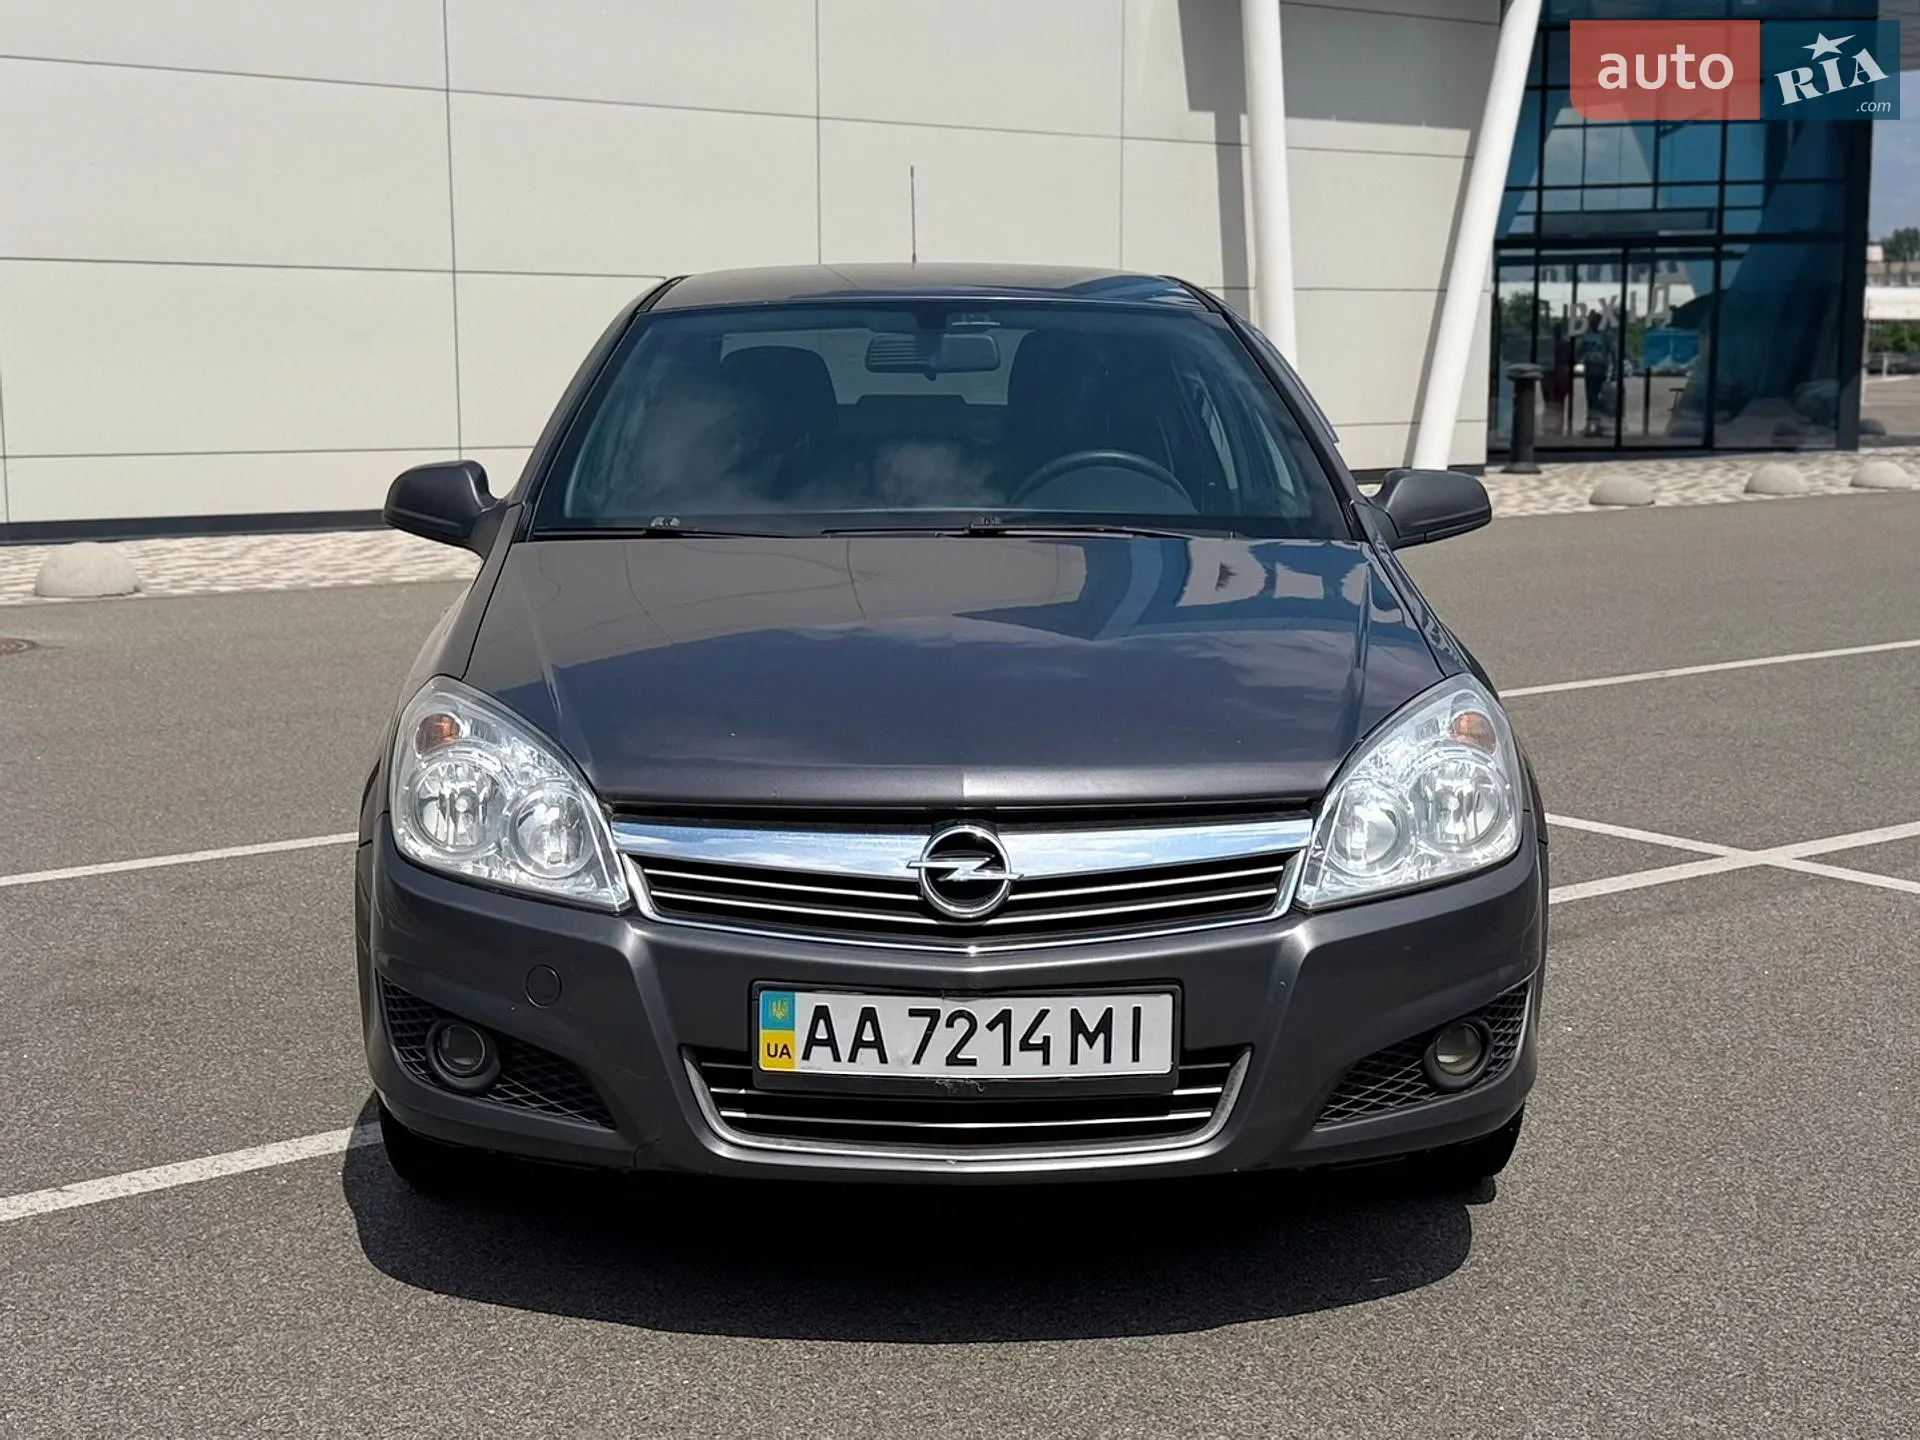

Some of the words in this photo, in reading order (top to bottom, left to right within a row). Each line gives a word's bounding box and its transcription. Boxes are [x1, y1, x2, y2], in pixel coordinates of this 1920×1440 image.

[766, 1043, 792, 1059] UA
[801, 1004, 890, 1065] AA
[907, 1007, 1051, 1067] 7214
